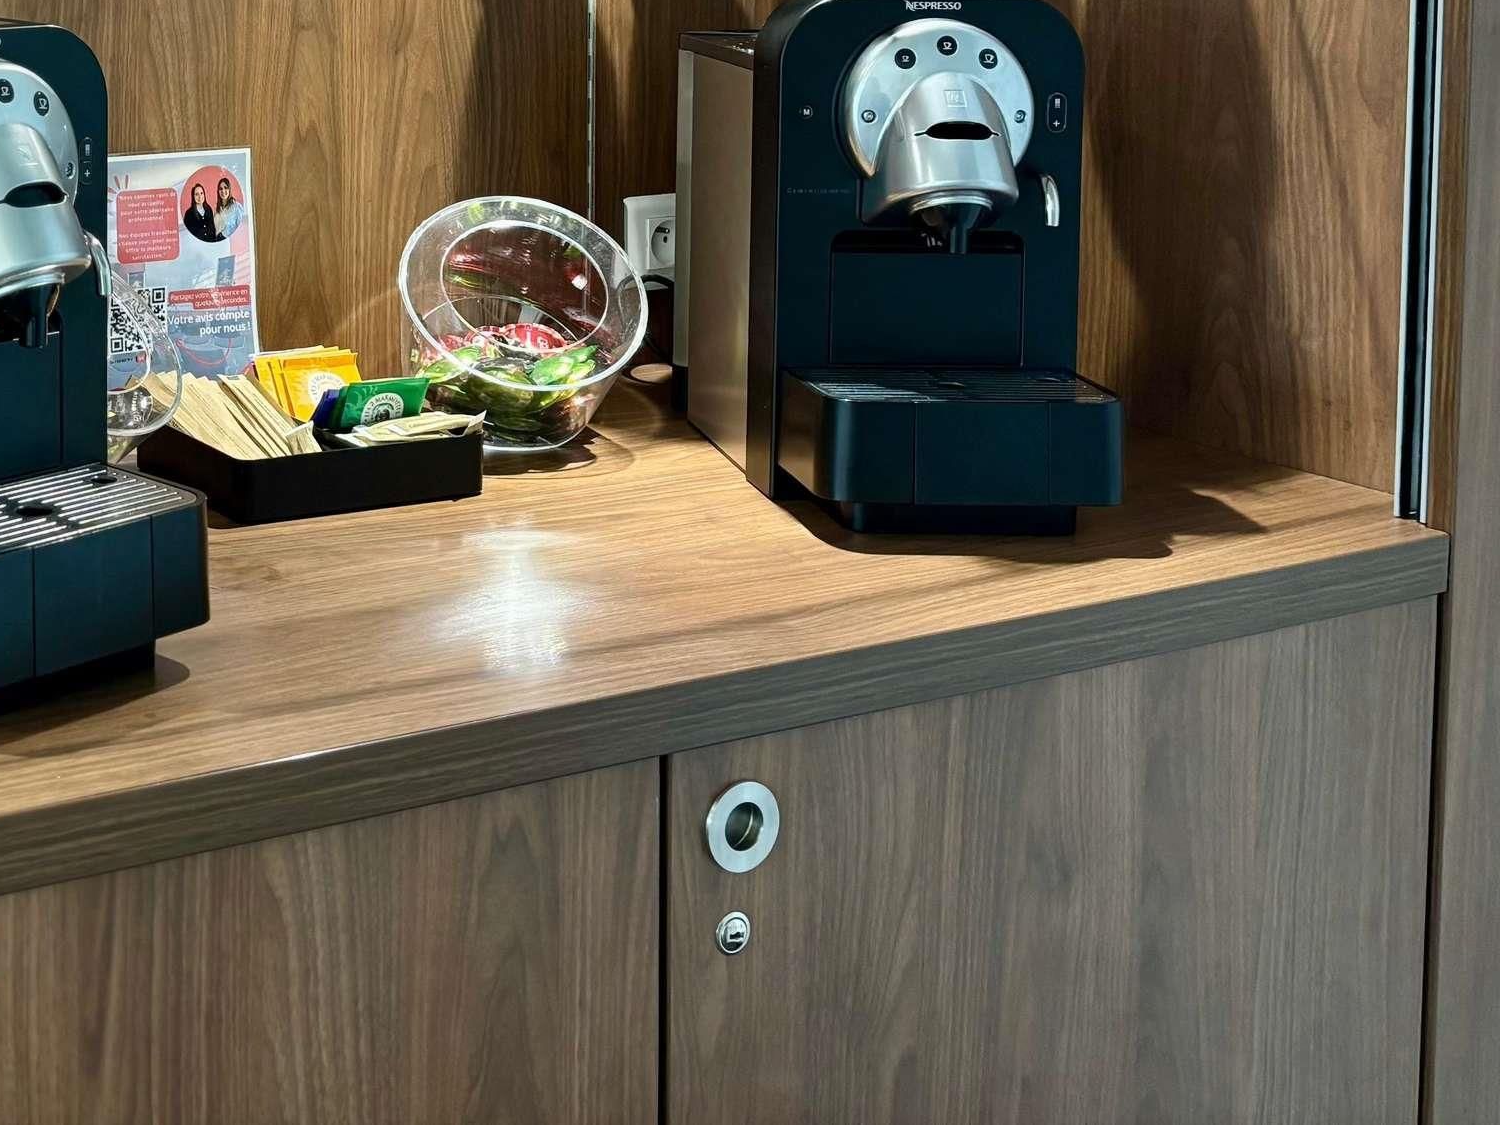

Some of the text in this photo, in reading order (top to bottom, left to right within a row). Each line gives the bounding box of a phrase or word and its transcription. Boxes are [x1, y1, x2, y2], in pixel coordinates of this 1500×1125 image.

[903, 0, 962, 12] NESPRESSO
[167, 309, 250, 325] Votre avis compte
[200, 325, 222, 337] pour
[223, 323, 245, 333] nous
